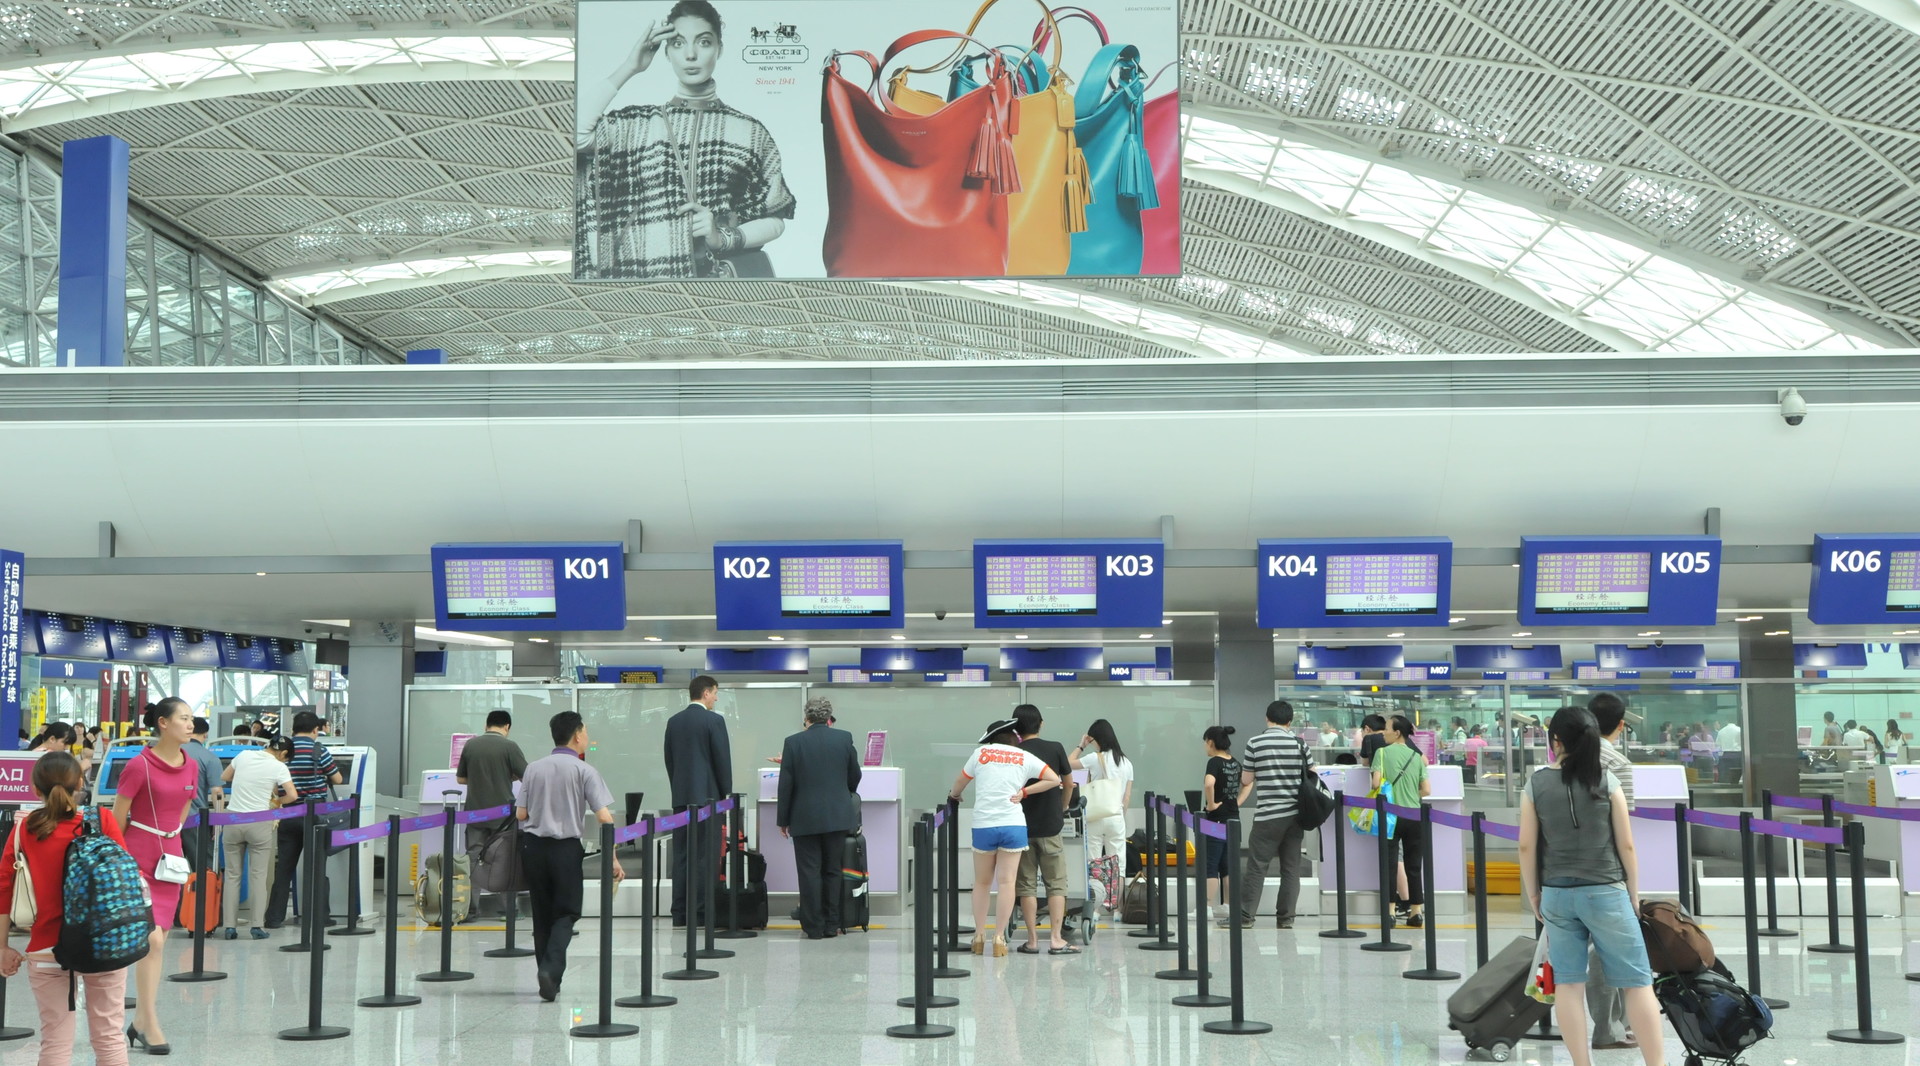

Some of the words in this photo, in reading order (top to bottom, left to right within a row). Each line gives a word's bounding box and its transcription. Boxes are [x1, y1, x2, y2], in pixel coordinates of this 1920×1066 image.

[565, 558, 608, 579] K01
[724, 557, 770, 578] K02
[1107, 555, 1153, 576] K03
[1269, 556, 1317, 576] K04
[1661, 552, 1710, 573] K05
[1831, 551, 1881, 572] K06
[7, 563, 20, 702] 自助办理乘机手续
[65, 663, 73, 676] 10
[978, 752, 1024, 766] ORANGE
[0, 768, 24, 782] 入口
